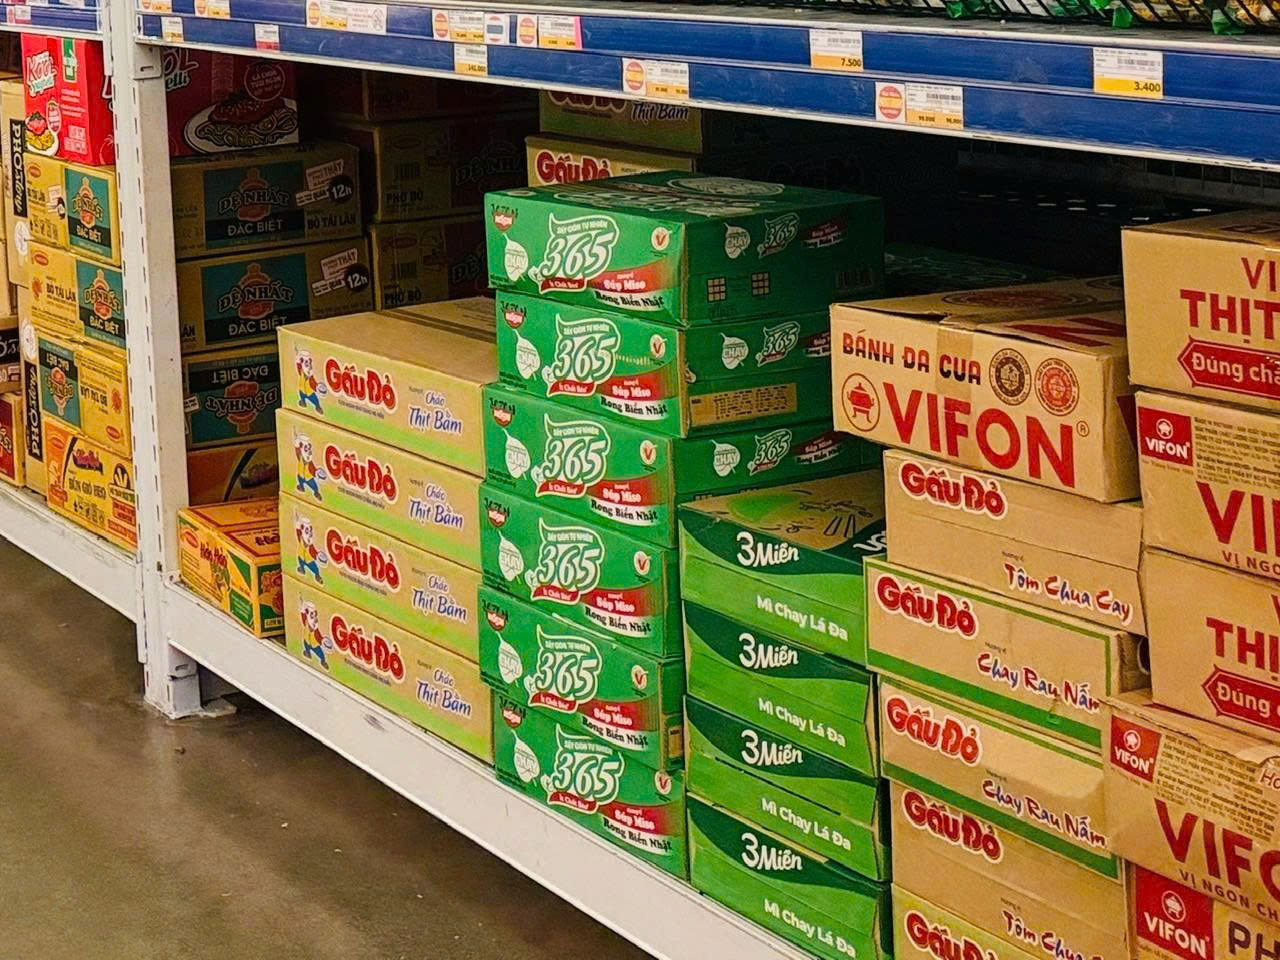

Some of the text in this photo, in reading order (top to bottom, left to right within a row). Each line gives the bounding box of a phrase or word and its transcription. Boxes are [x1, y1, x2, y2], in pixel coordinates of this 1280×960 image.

[841, 57, 862, 68] 7.500
[1133, 80, 1161, 93] 3.400
[540, 231, 615, 280] 365
[595, 291, 620, 306] Rong
[642, 295, 665, 309] Nhật
[553, 334, 619, 382] 365
[842, 328, 895, 366] BÁNH
[901, 346, 931, 374] ĐA
[939, 353, 982, 386] CUA
[1191, 351, 1244, 383] Đúng
[325, 358, 367, 401] Gấu
[367, 373, 398, 410] Đỏ
[425, 391, 445, 407] Cháo
[600, 396, 622, 413] Rong
[646, 402, 668, 417] Nhật
[408, 406, 429, 431] Thịt
[434, 410, 463, 433] Bằm
[882, 380, 1076, 490] VIFON
[543, 438, 607, 484] 365
[1145, 437, 1188, 459] VIFON
[324, 444, 398, 501] Gấu Đỏ
[425, 484, 446, 500] Cháo
[900, 461, 1006, 518] Gấu Đỏ
[408, 498, 464, 528] Thịt Bằm
[326, 528, 401, 591] Gấu Đỏ
[537, 543, 601, 591] 365
[1222, 550, 1240, 568] VỊ
[412, 587, 467, 622] Thịt Bằm
[428, 575, 449, 592] Cháo
[876, 576, 977, 637] Gấu Đỏ
[1004, 561, 1133, 625] Tôm Chua Cay
[757, 595, 849, 642] Mì Chay Lá Đa
[330, 614, 406, 681] Gấu Đỏ
[416, 679, 472, 717] Thịt Bằm
[434, 668, 455, 686] Cháo
[536, 652, 599, 701] 365
[977, 652, 1020, 689] Chay
[1024, 666, 1060, 698] Rau
[758, 696, 847, 749] Mì Chay Lá Đa
[1217, 683, 1271, 715] Đúng
[885, 696, 982, 764] Gấu Đỏ
[554, 751, 622, 801] 365
[1114, 745, 1152, 774] VIFON
[761, 797, 852, 852] Mì Chay Lá Đa
[903, 790, 1003, 862] Gấu Đỏ
[982, 778, 1107, 848] Chay Rau Nấm
[1178, 868, 1251, 909] VỊ NGON
[763, 898, 857, 959] Mì Chay Lá Đa
[1003, 910, 1037, 943] Tôm
[1143, 911, 1207, 959] VIFON
